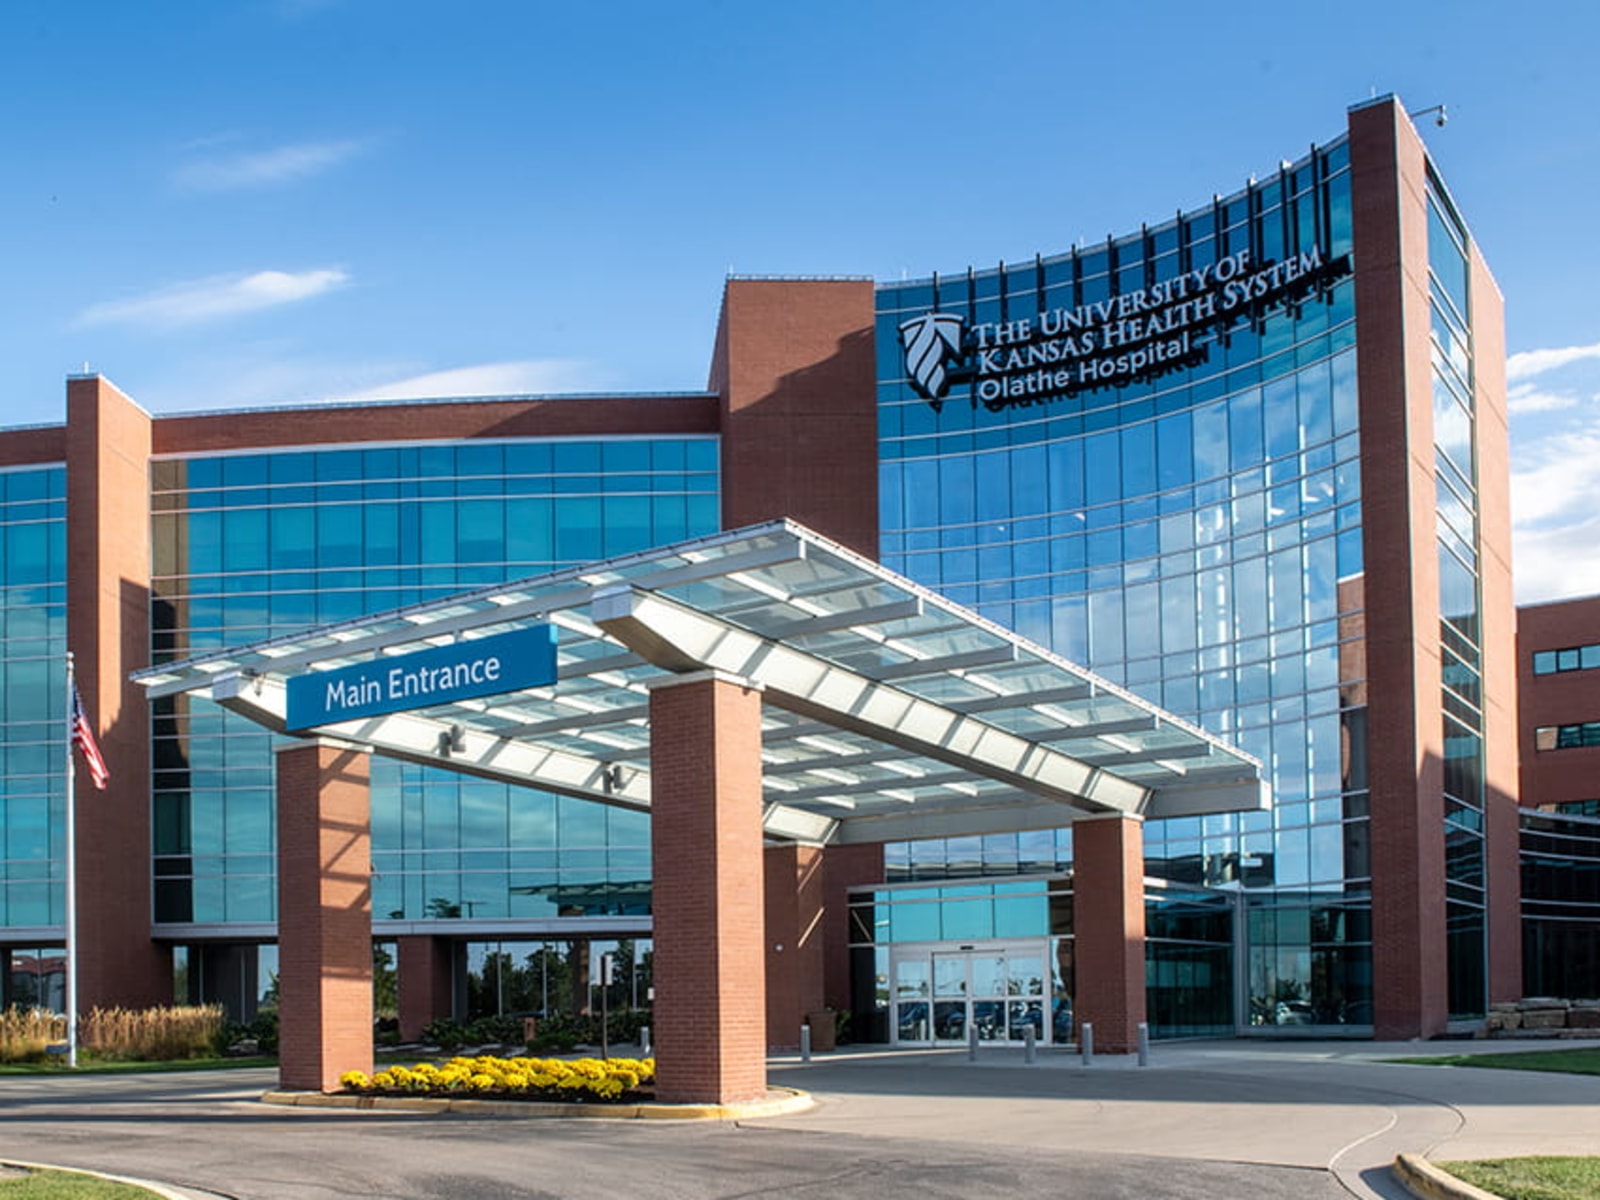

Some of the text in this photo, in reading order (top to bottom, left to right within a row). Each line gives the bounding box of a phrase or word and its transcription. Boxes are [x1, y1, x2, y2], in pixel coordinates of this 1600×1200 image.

[971, 248, 1250, 349] THE UNIVERSITY OF
[978, 243, 1323, 375] KANSAS HEALTH SYSTEM
[979, 331, 1189, 400] Olathe Hospital
[325, 657, 500, 712] Main Entrance
